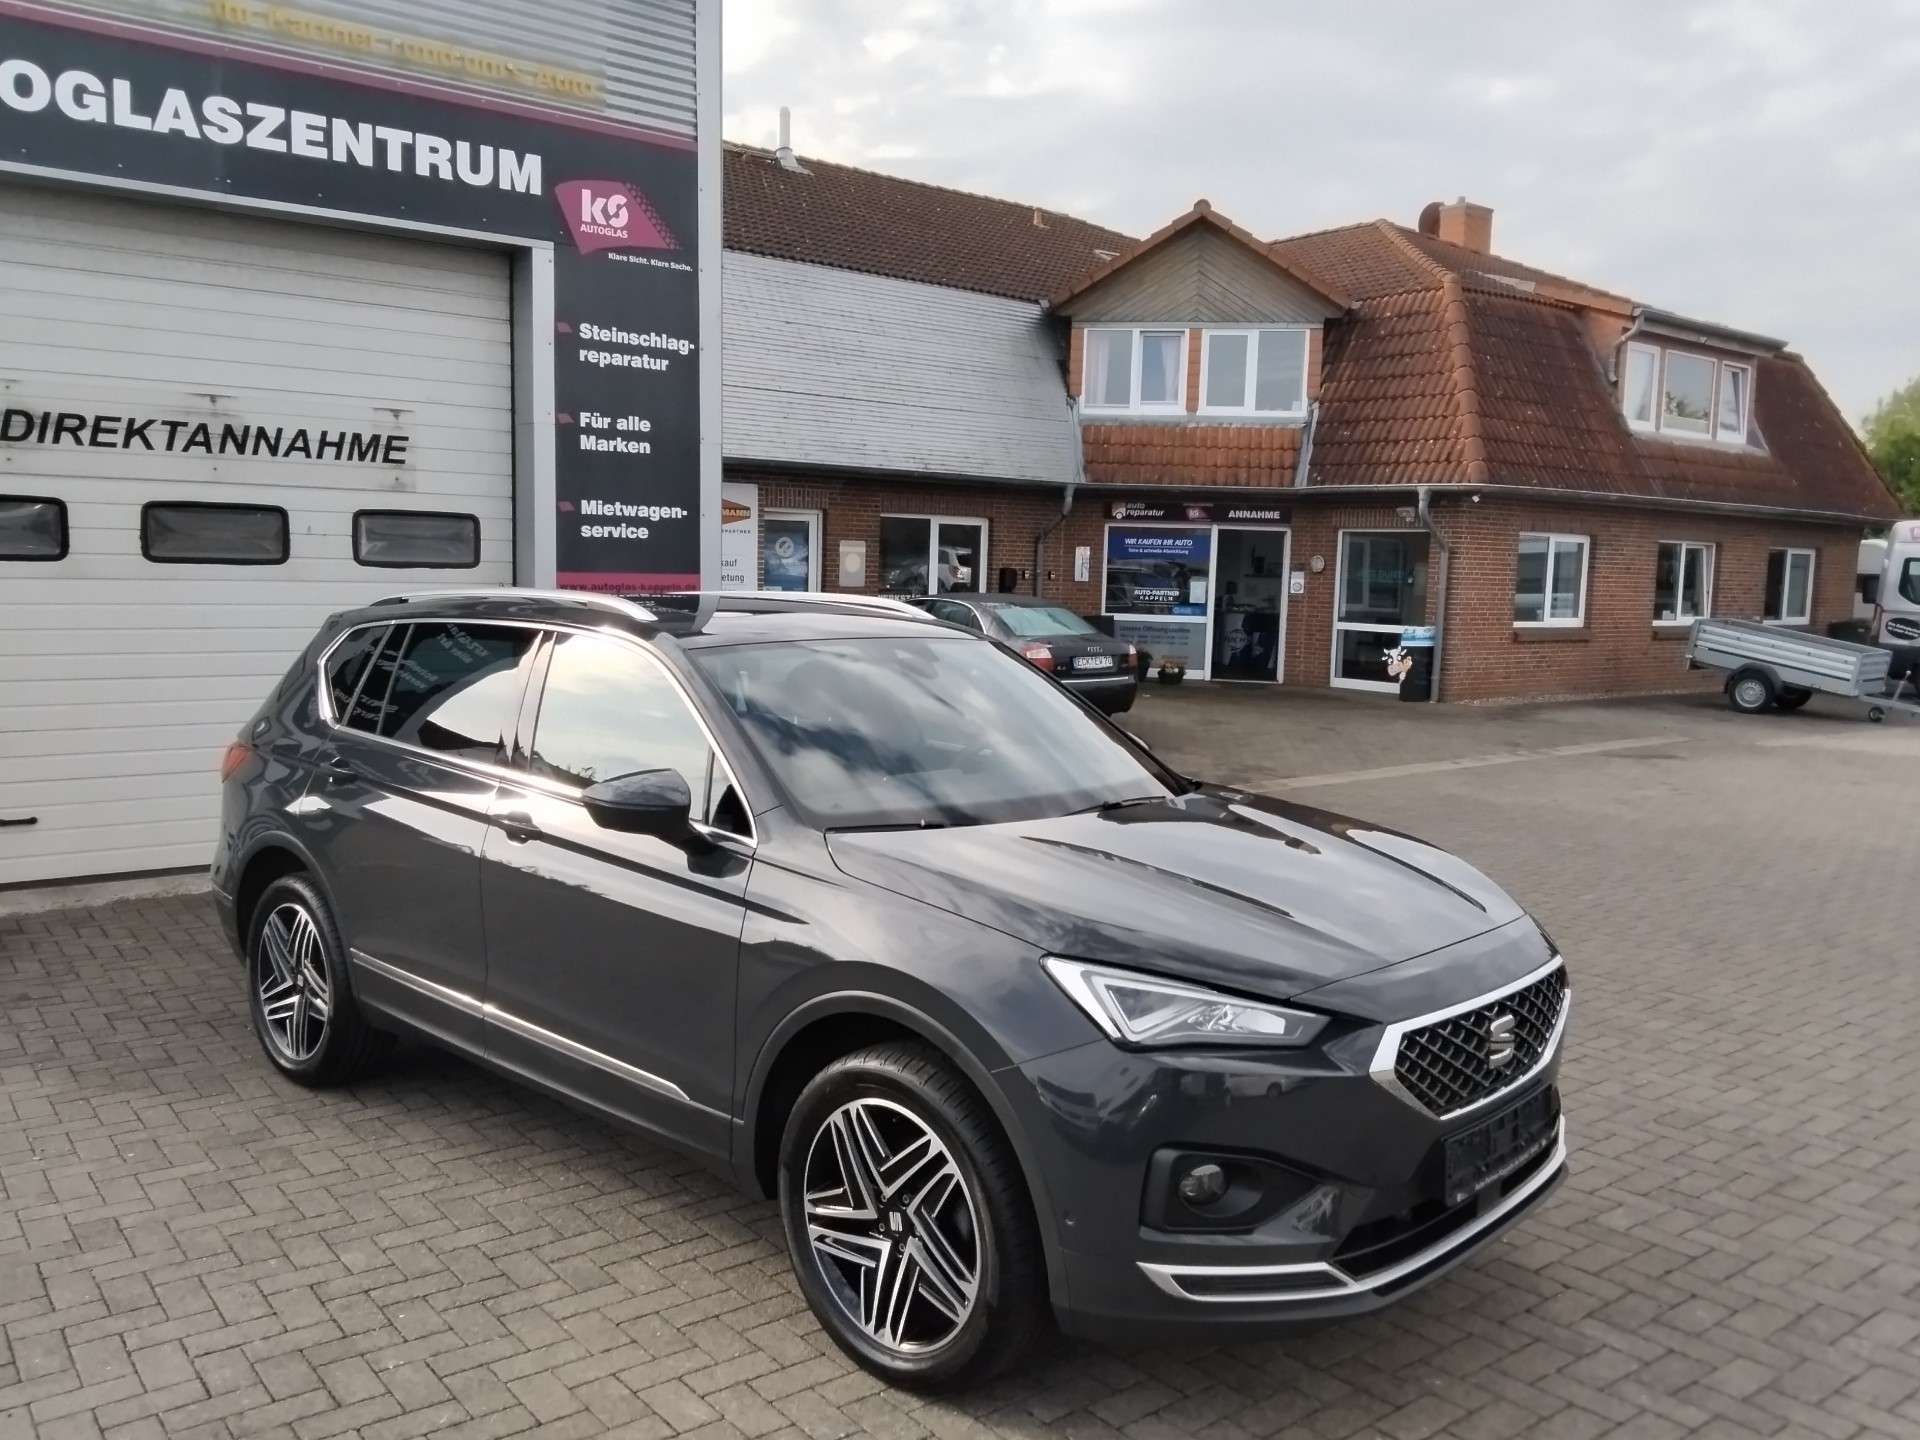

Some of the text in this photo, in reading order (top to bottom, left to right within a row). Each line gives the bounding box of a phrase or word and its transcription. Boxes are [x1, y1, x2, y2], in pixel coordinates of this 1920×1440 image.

[0, 59, 542, 196] OGLASZENTRUM
[580, 224, 628, 239] AUTOGLAS
[608, 252, 693, 272] Klare Sicht. Klare Sache.
[579, 322, 695, 355] Steinschlag-
[579, 349, 669, 371] reparatur
[580, 411, 651, 432] Für alle
[0, 408, 410, 465] DIREKTANNAHME
[580, 434, 651, 454] Marken
[580, 499, 688, 521] Mietwagen-
[1127, 509, 1165, 517] reparatur
[1228, 509, 1281, 519] ANNAHME
[580, 523, 649, 539] service
